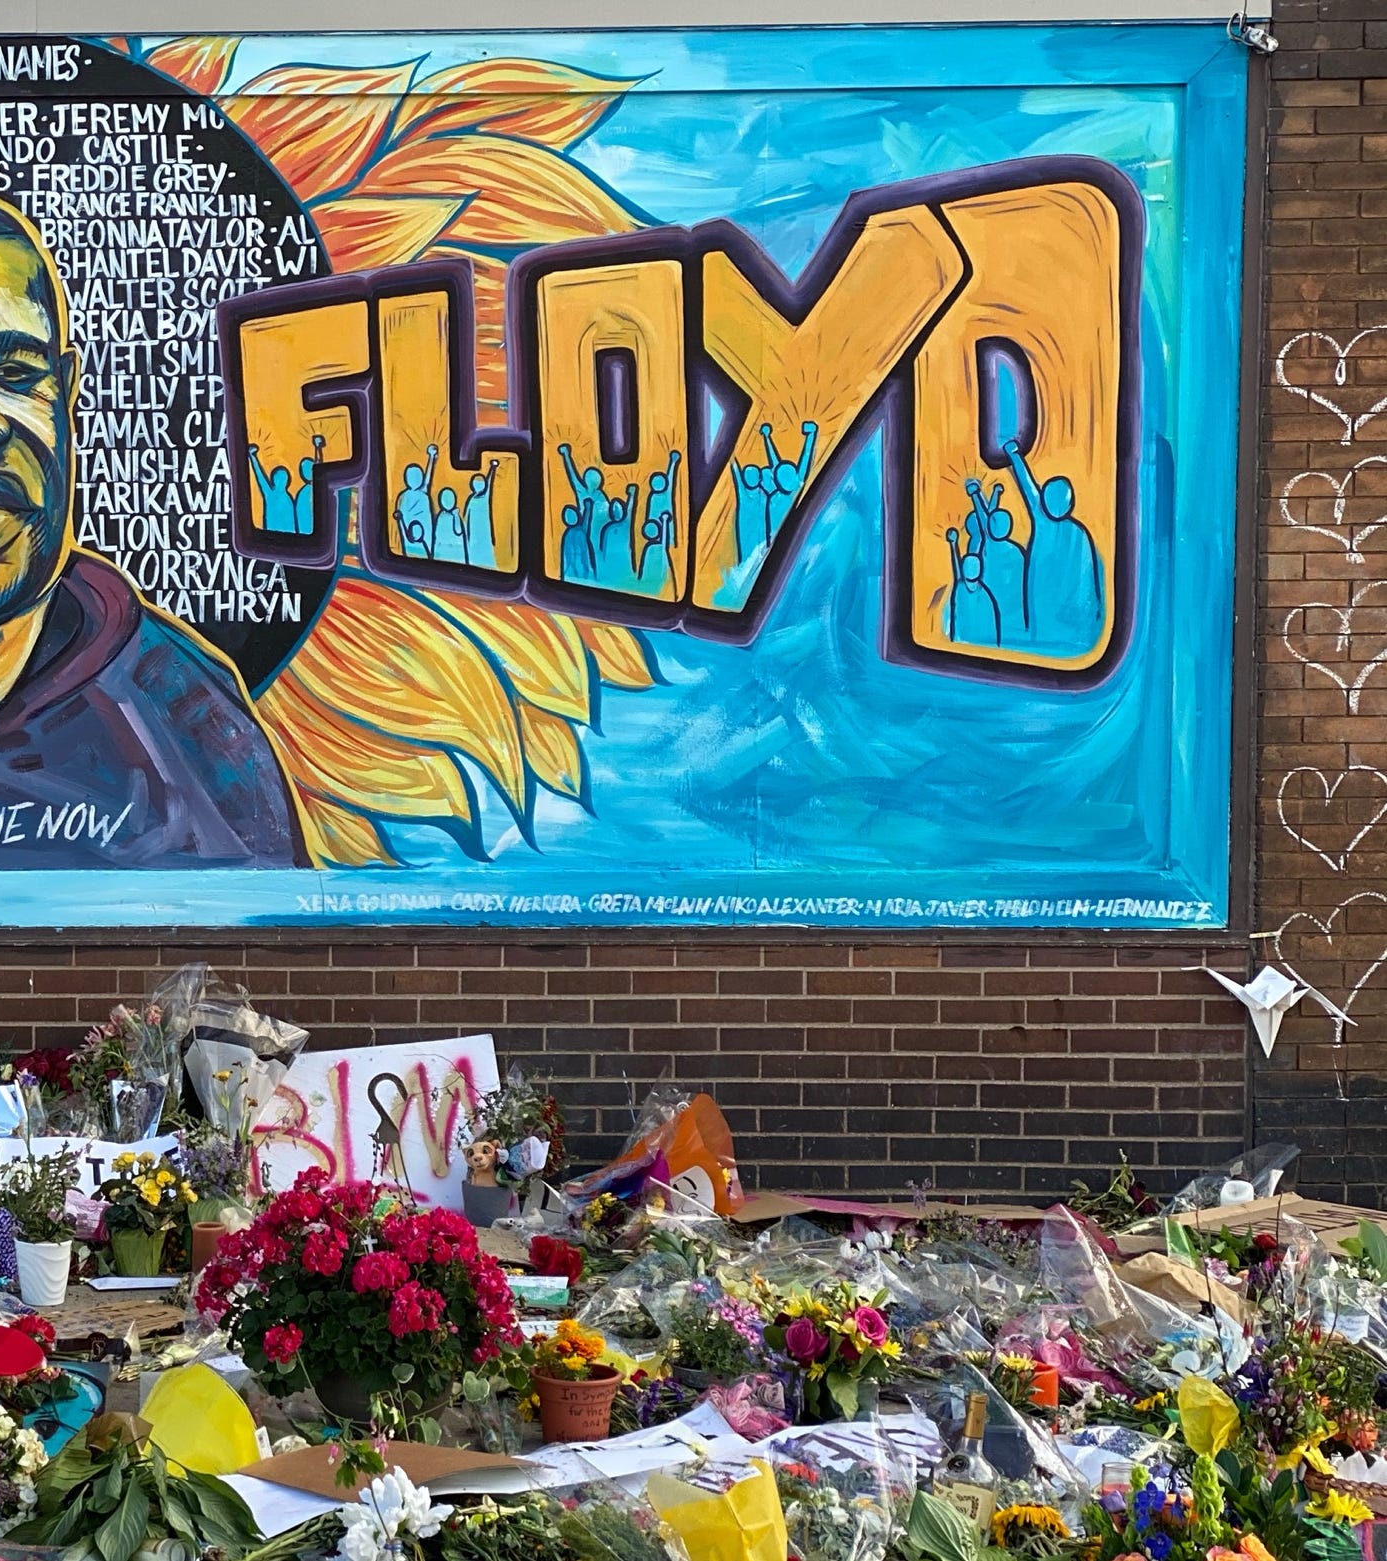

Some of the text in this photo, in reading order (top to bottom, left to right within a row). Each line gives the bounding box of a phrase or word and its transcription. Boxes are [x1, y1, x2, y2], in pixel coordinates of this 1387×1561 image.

[50, 103, 170, 135] JEREMY
[82, 134, 195, 165] CASTILE
[33, 163, 147, 193] FREDDIE
[153, 162, 229, 194] GREY
[14, 191, 258, 218] TERRANCE FRANKLIN
[55, 247, 179, 280] SHANTEL
[181, 246, 265, 279] DAVIS
[61, 277, 177, 311] WALTER
[69, 309, 154, 342] REKIA
[72, 340, 160, 375] YVETT
[78, 374, 179, 410] SHELLY
[72, 410, 178, 449] JAMAR
[234, 175, 1128, 675] FLOYD
[75, 448, 201, 484] TANISHA
[76, 482, 184, 515] TARIKA
[77, 514, 229, 550] ALTON STE
[156, 590, 302, 625] KATHRYN
[36, 801, 136, 847] NOW
[296, 894, 354, 912] XENA
[588, 893, 643, 914] GRETA
